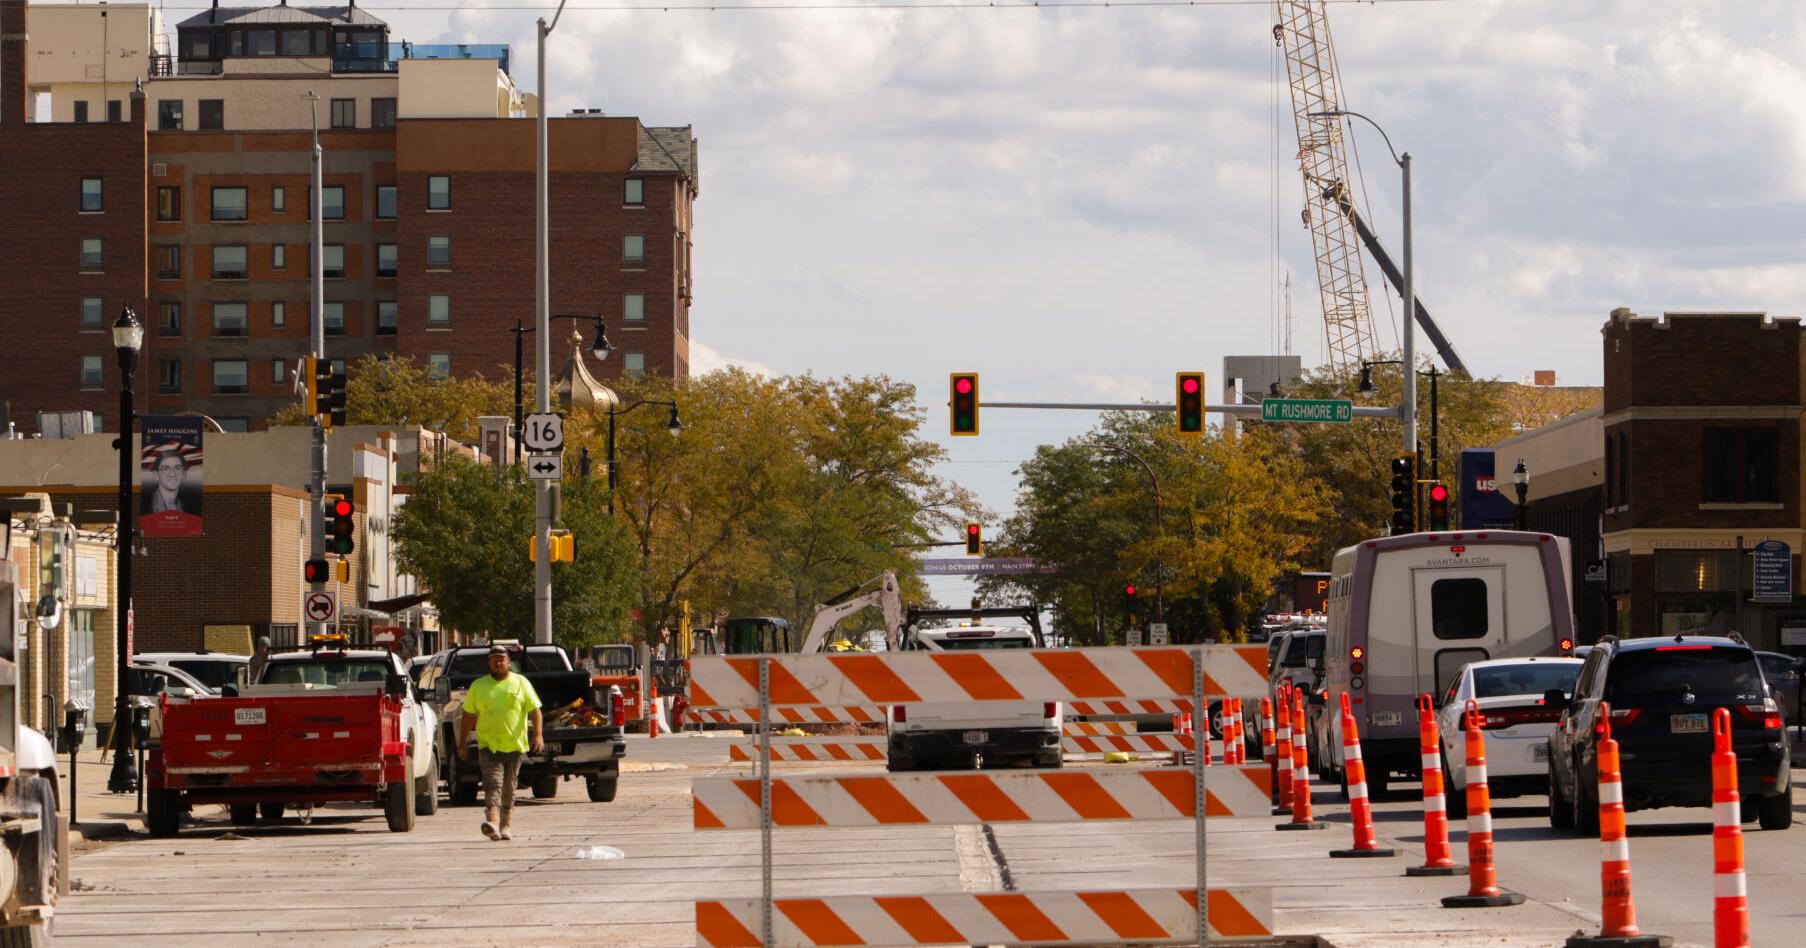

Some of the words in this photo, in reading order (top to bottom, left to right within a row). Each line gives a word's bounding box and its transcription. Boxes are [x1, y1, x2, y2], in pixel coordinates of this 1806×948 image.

[1265, 403, 1278, 417] MT
[1281, 404, 1332, 419] RUSHMORE
[1336, 405, 1349, 419] RD
[532, 421, 556, 441] 16
[1426, 557, 1490, 566] AVANTARA.COM
